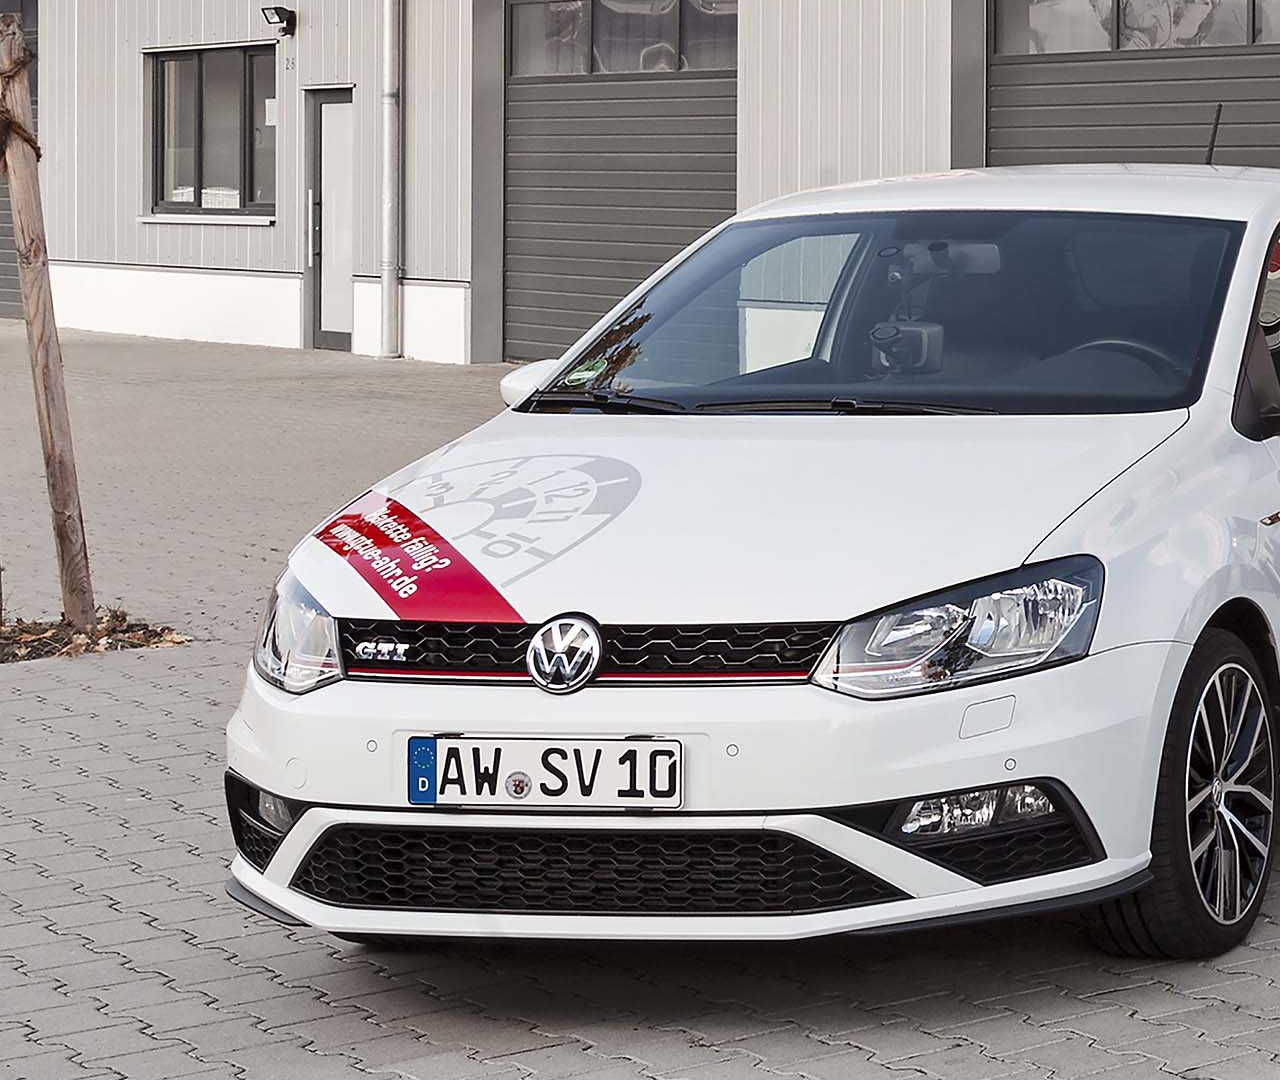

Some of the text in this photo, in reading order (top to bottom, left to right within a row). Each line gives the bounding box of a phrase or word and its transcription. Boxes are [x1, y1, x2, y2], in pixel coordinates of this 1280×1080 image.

[544, 481, 591, 504] 12
[400, 536, 451, 572] fällig?
[481, 532, 541, 559] 10
[329, 523, 418, 598] www.gtue-ahr.de
[356, 642, 409, 661] GTI
[418, 777, 429, 792] D
[439, 747, 502, 796] AW
[539, 748, 602, 797] SV
[617, 749, 677, 798] 10
